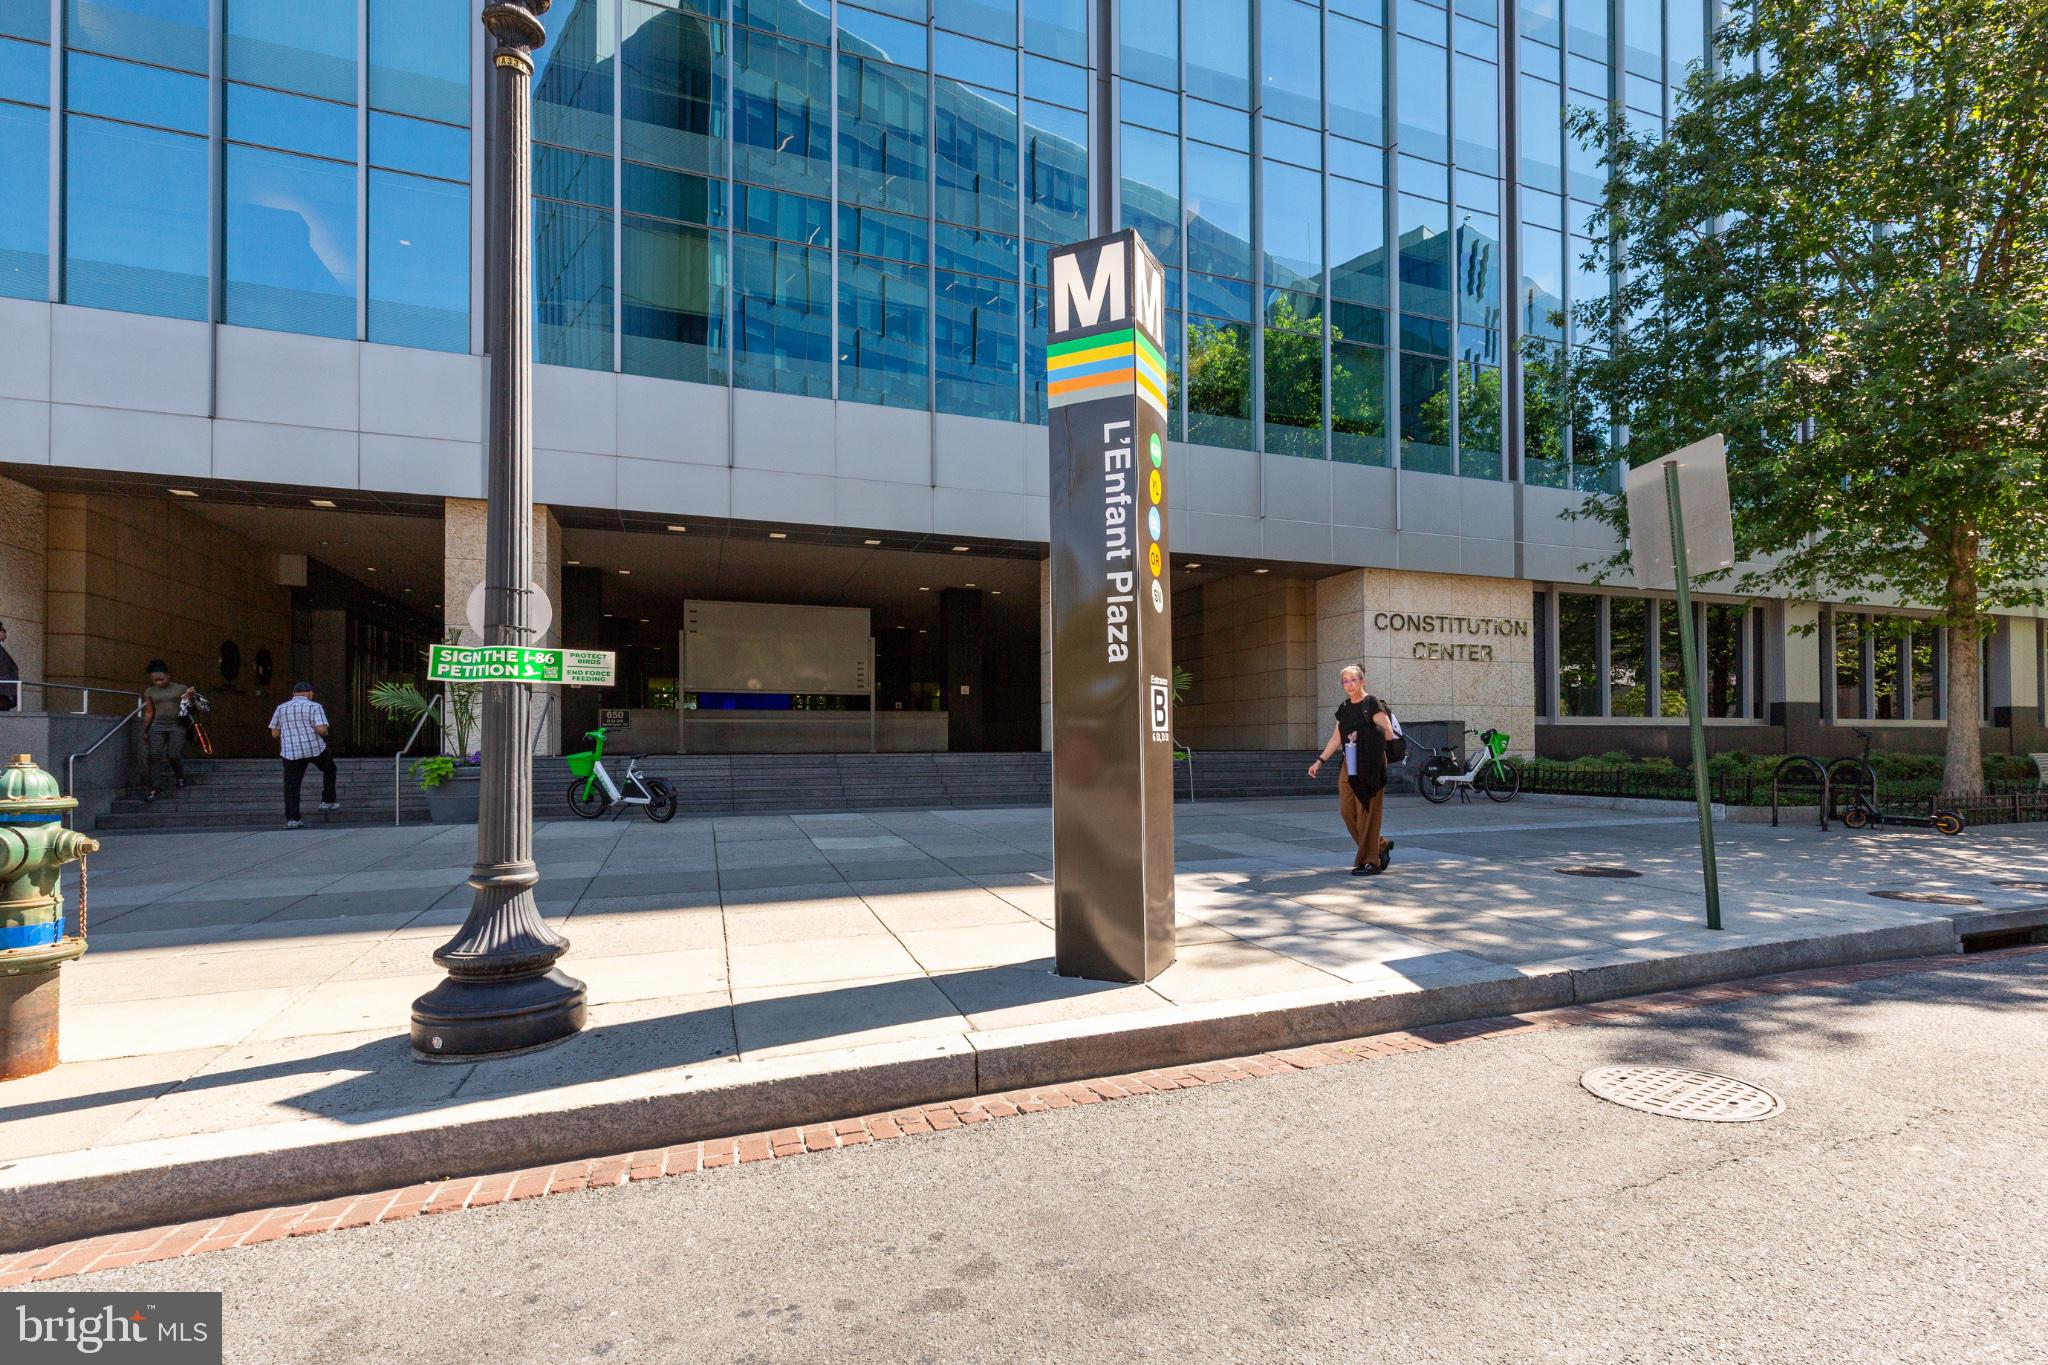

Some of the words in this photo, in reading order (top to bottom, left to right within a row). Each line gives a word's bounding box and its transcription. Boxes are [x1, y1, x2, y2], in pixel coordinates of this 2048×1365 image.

[1053, 240, 1126, 334] M
[1135, 243, 1163, 349] M
[1103, 419, 1132, 561] L'Enfant
[1151, 552, 1160, 568] OR
[1106, 571, 1134, 664] Plaza
[1374, 612, 1529, 637] CONSTITUTION
[439, 649, 482, 664] SIGN
[483, 650, 519, 662] THE
[570, 652, 608, 660] PROTECT
[1412, 641, 1494, 662] CENTER
[437, 663, 519, 677] PETITION
[606, 711, 624, 719] 650
[1154, 688, 1166, 727] B
